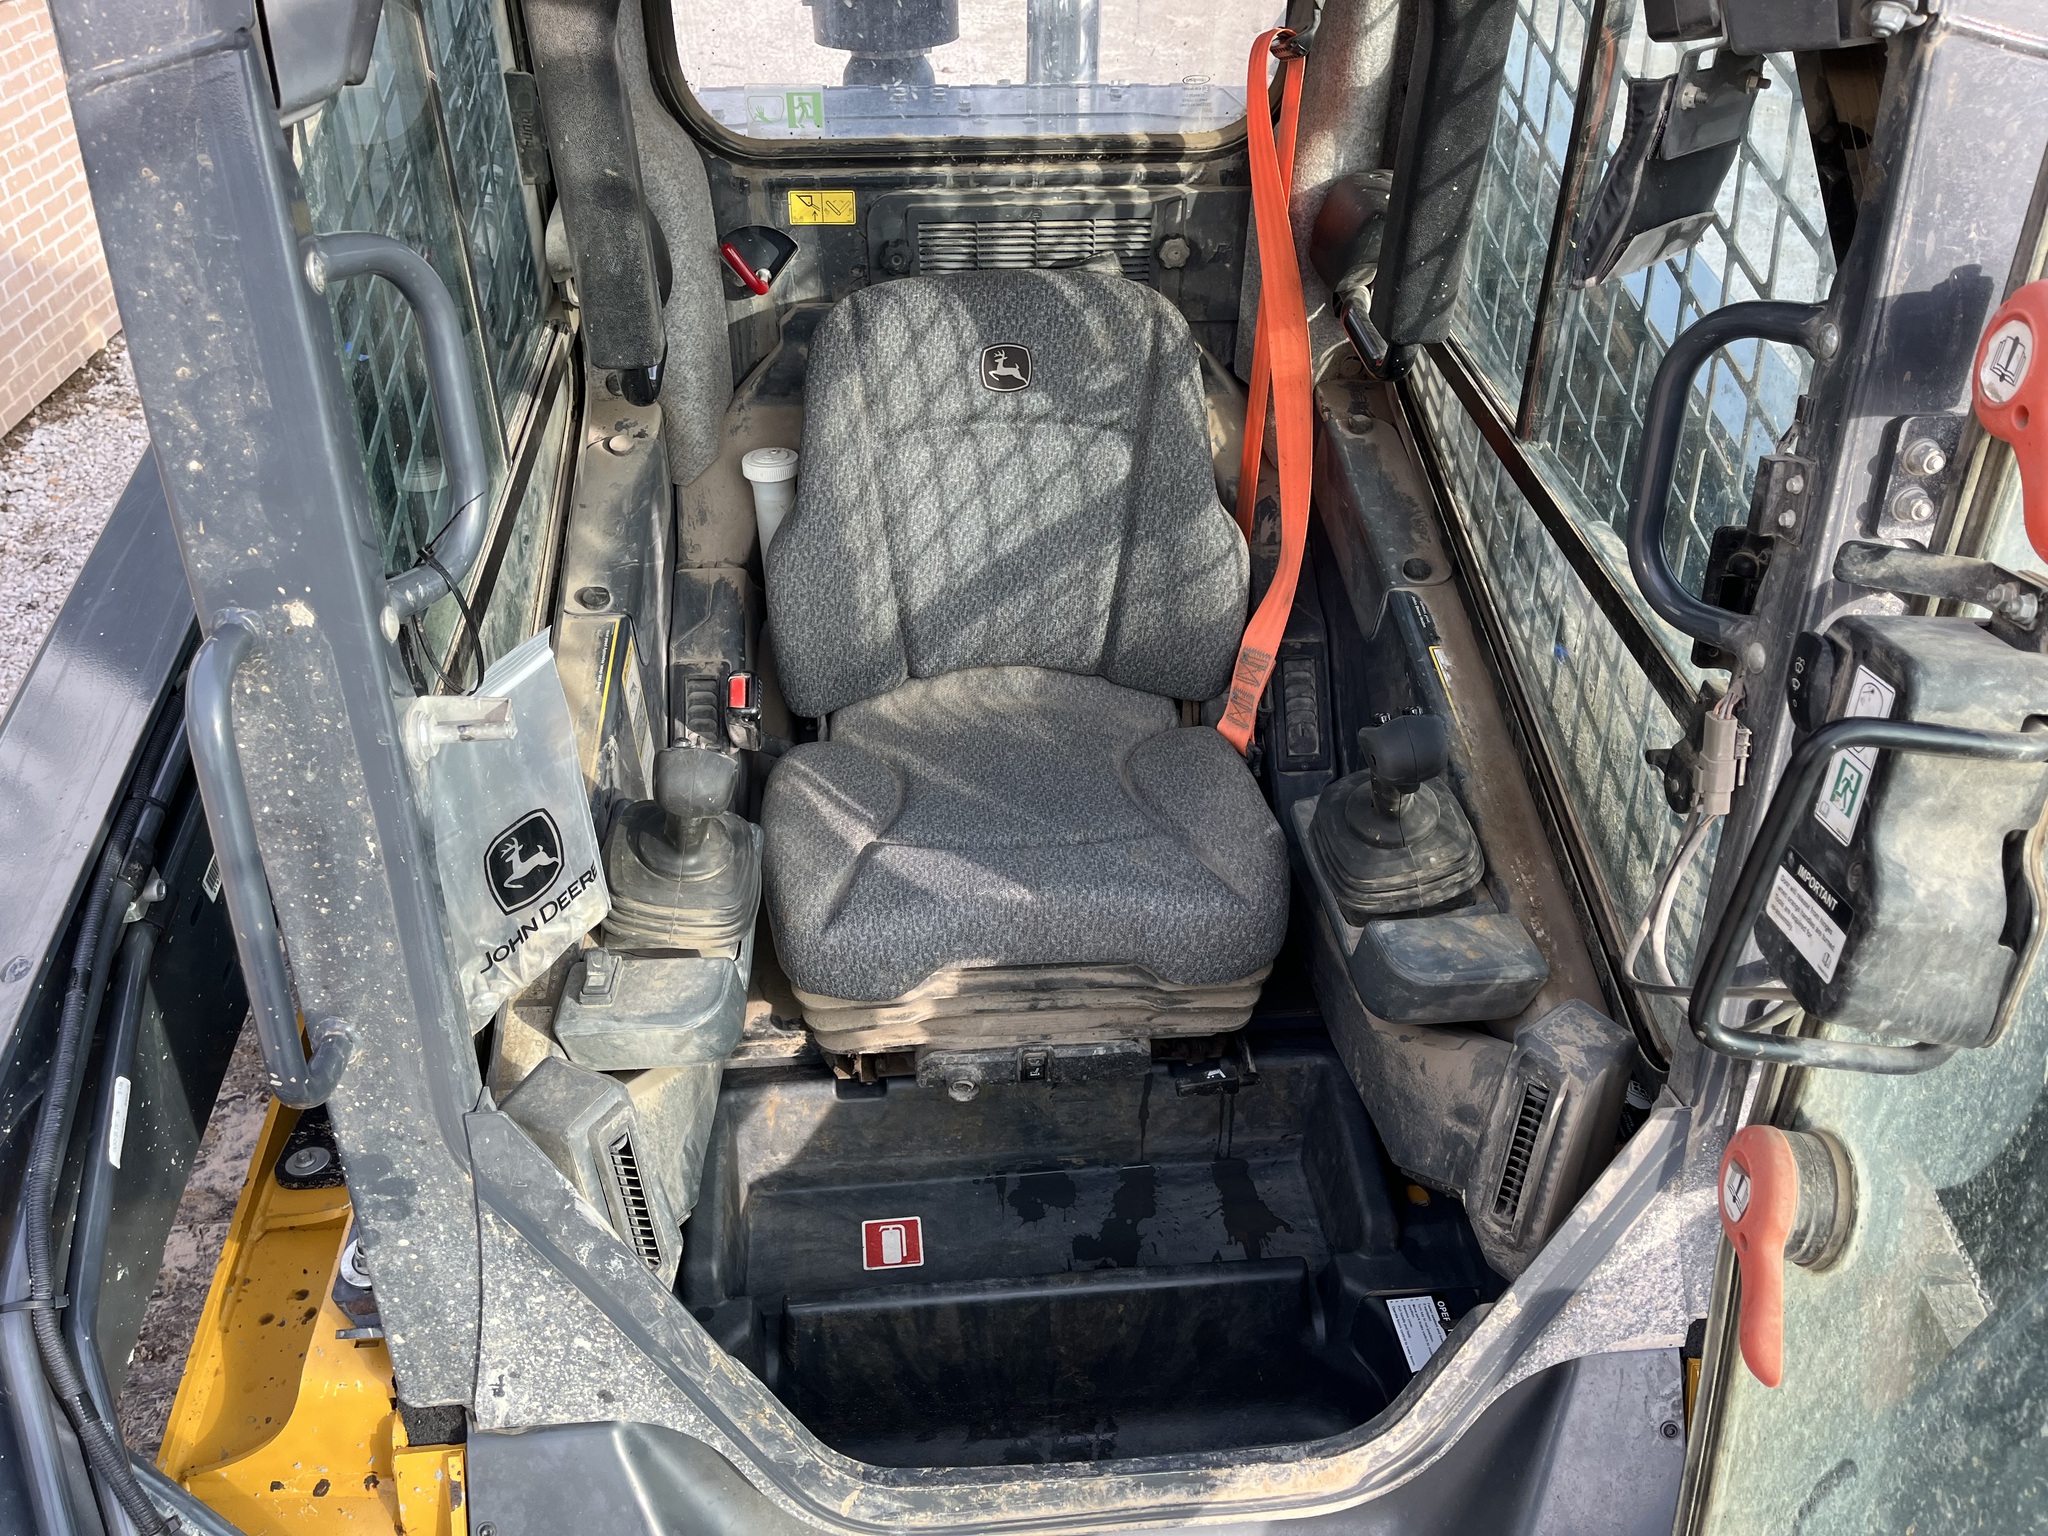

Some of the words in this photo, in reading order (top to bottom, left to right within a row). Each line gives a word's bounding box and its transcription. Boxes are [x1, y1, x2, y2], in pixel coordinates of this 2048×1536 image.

[480, 917, 539, 974] JOHN
[539, 860, 598, 924] DEERE
[1797, 864, 1839, 912] IMPORTANT
